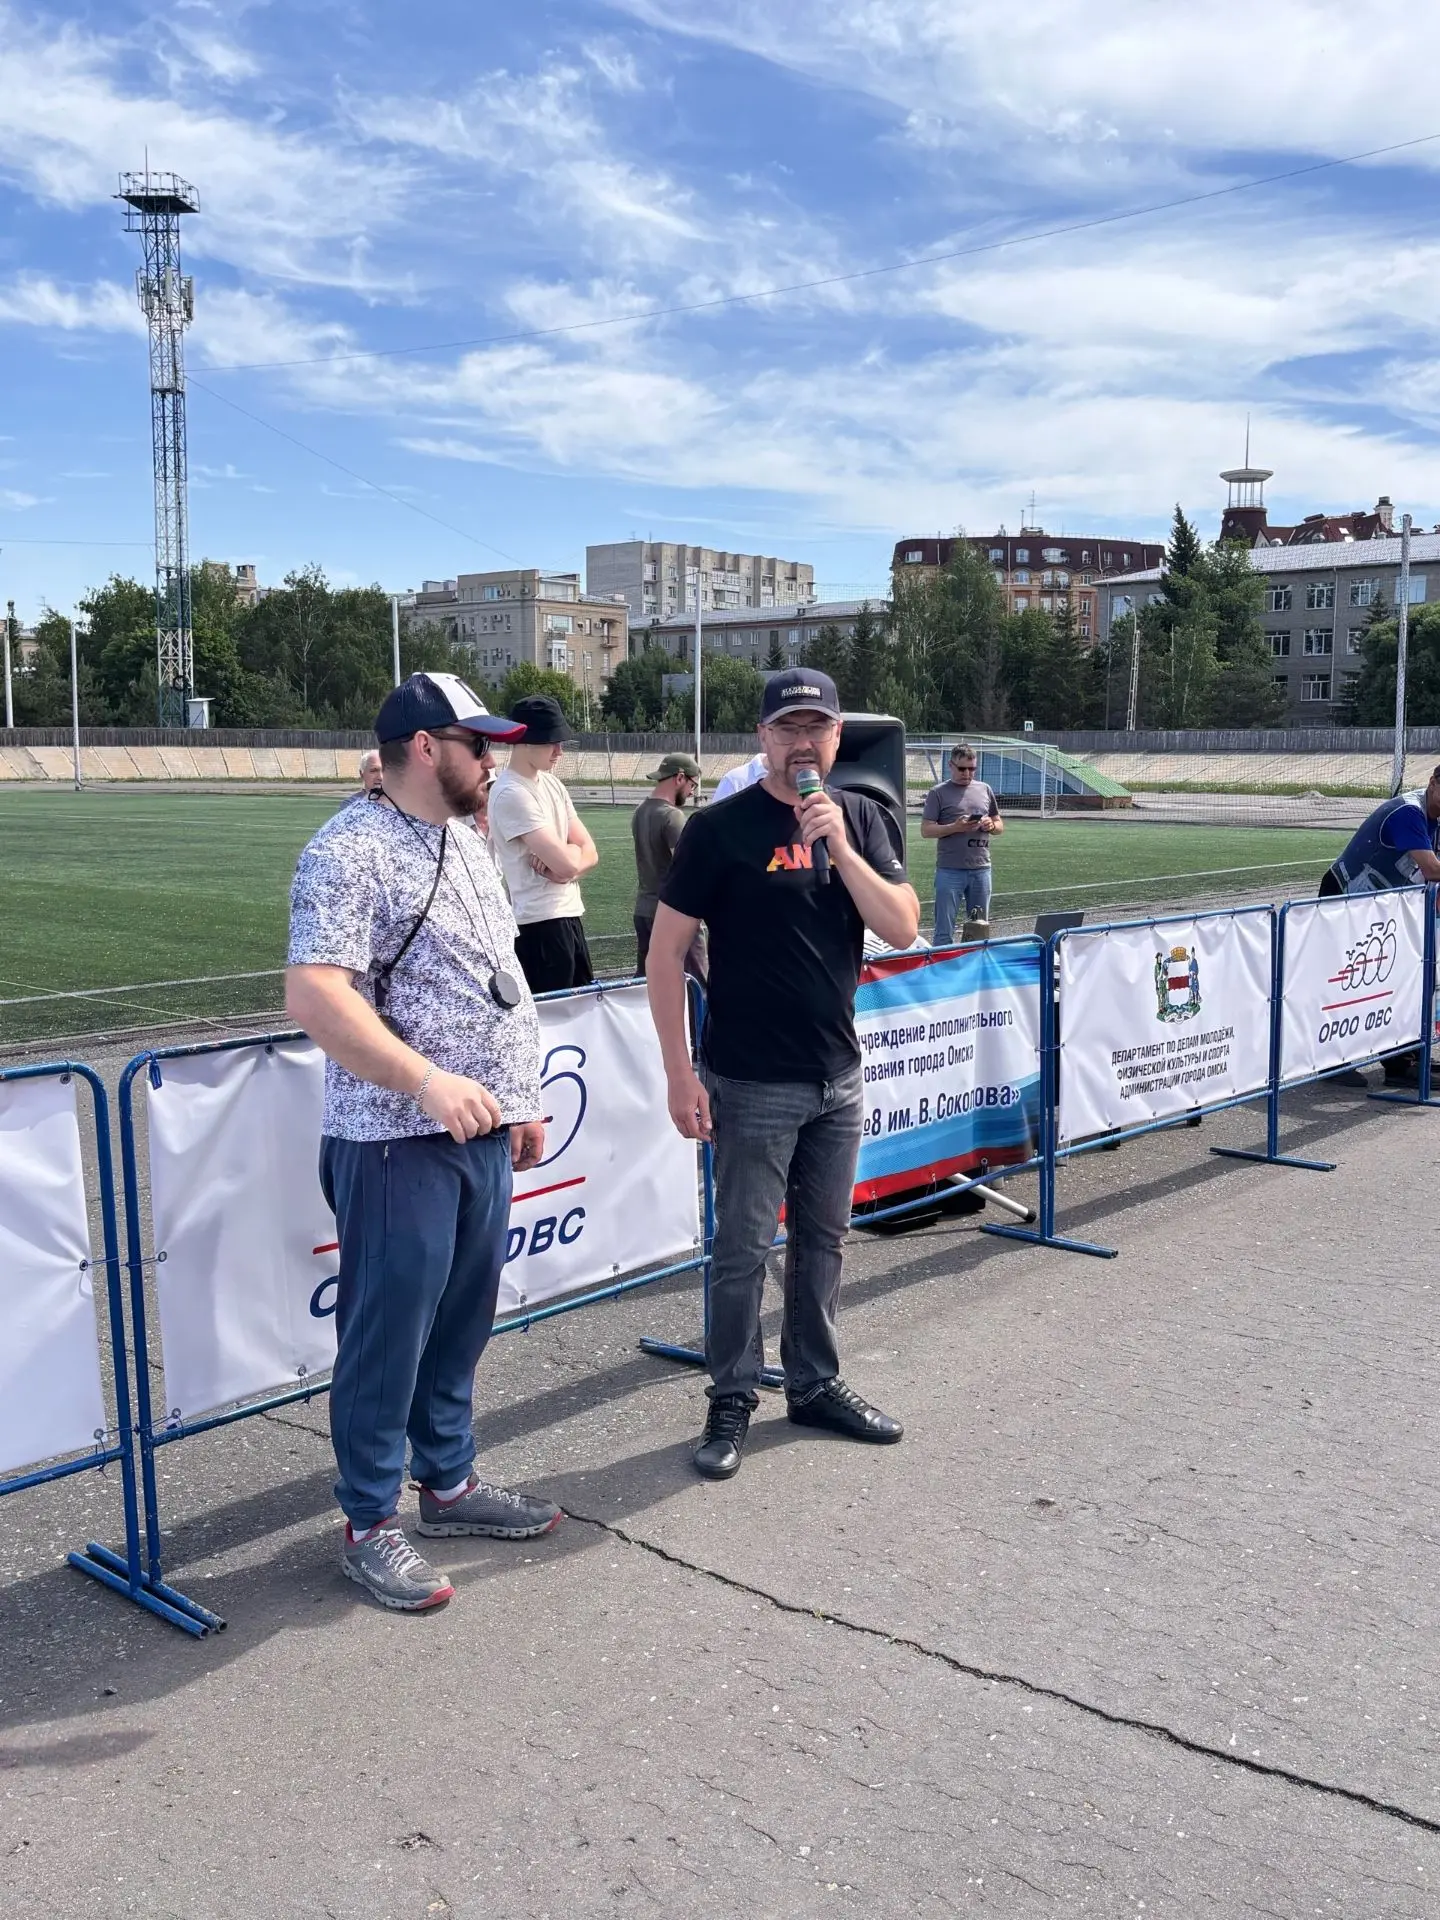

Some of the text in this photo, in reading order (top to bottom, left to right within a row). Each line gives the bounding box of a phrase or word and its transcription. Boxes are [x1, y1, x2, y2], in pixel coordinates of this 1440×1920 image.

[929, 1010, 1013, 1043] дополнительного
[1318, 1006, 1392, 1043] ОРОО ФВС
[908, 1051, 945, 1077] города
[947, 1044, 974, 1066] Омска
[1112, 1042, 1165, 1066] ДЕПАРТАМЕНТ
[1166, 1040, 1176, 1054] ПО
[1176, 1034, 1199, 1053] ДЕЛАМ
[1116, 1044, 1230, 1080] ФИЗИЧЕСКОЙ КУЛЬТУРЫ И СПОРТА
[1119, 1061, 1228, 1100] АДМИНИСТРАЦИИ ГОРОДА ОМСКА
[888, 1107, 914, 1132] им.
[919, 1097, 932, 1125] В.
[936, 1085, 1020, 1120] Соколова»
